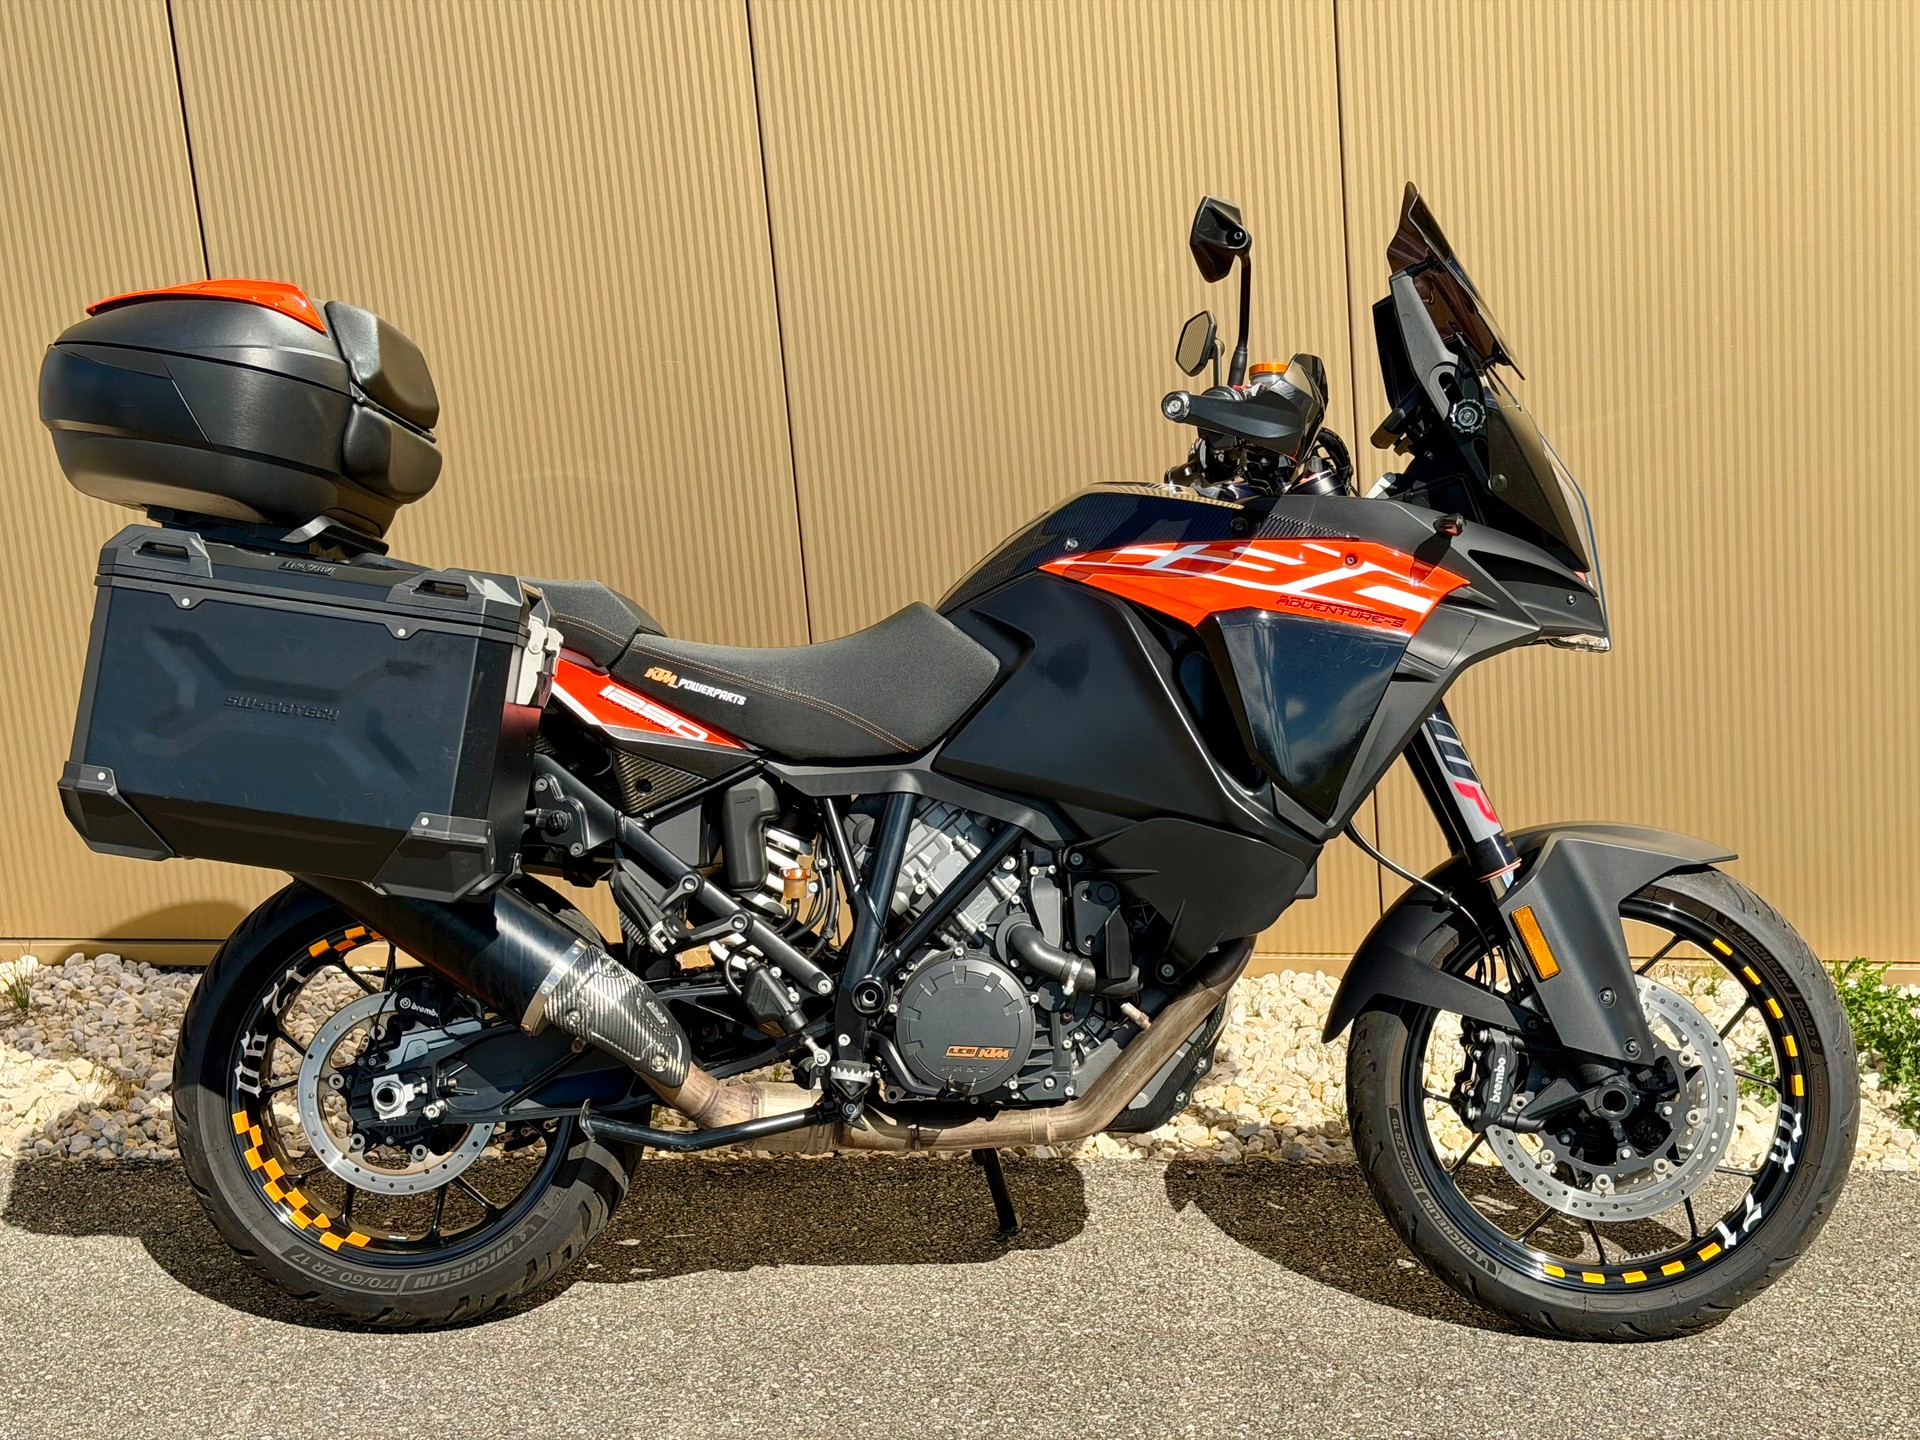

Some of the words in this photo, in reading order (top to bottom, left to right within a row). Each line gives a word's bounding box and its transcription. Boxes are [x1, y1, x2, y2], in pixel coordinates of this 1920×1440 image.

[644, 666, 678, 689] KTM
[678, 678, 747, 706] POWERPARTS
[224, 696, 340, 721] SW-MOTECH
[1739, 929, 1794, 992] MICHELIN
[1793, 1000, 1817, 1036] ROAD
[1810, 1039, 1821, 1048] 6
[978, 1047, 1009, 1059] KTM
[1489, 1057, 1507, 1103] brembo
[1392, 1117, 1400, 1130] 19
[1395, 1132, 1404, 1148] ZR
[1400, 1150, 1419, 1187] 120/70
[1422, 1198, 1475, 1257] MICHELIN
[290, 1252, 311, 1267] 17
[310, 1260, 338, 1278] ZR
[413, 1242, 516, 1289] MICHELIN
[339, 1270, 400, 1289] 170/60
